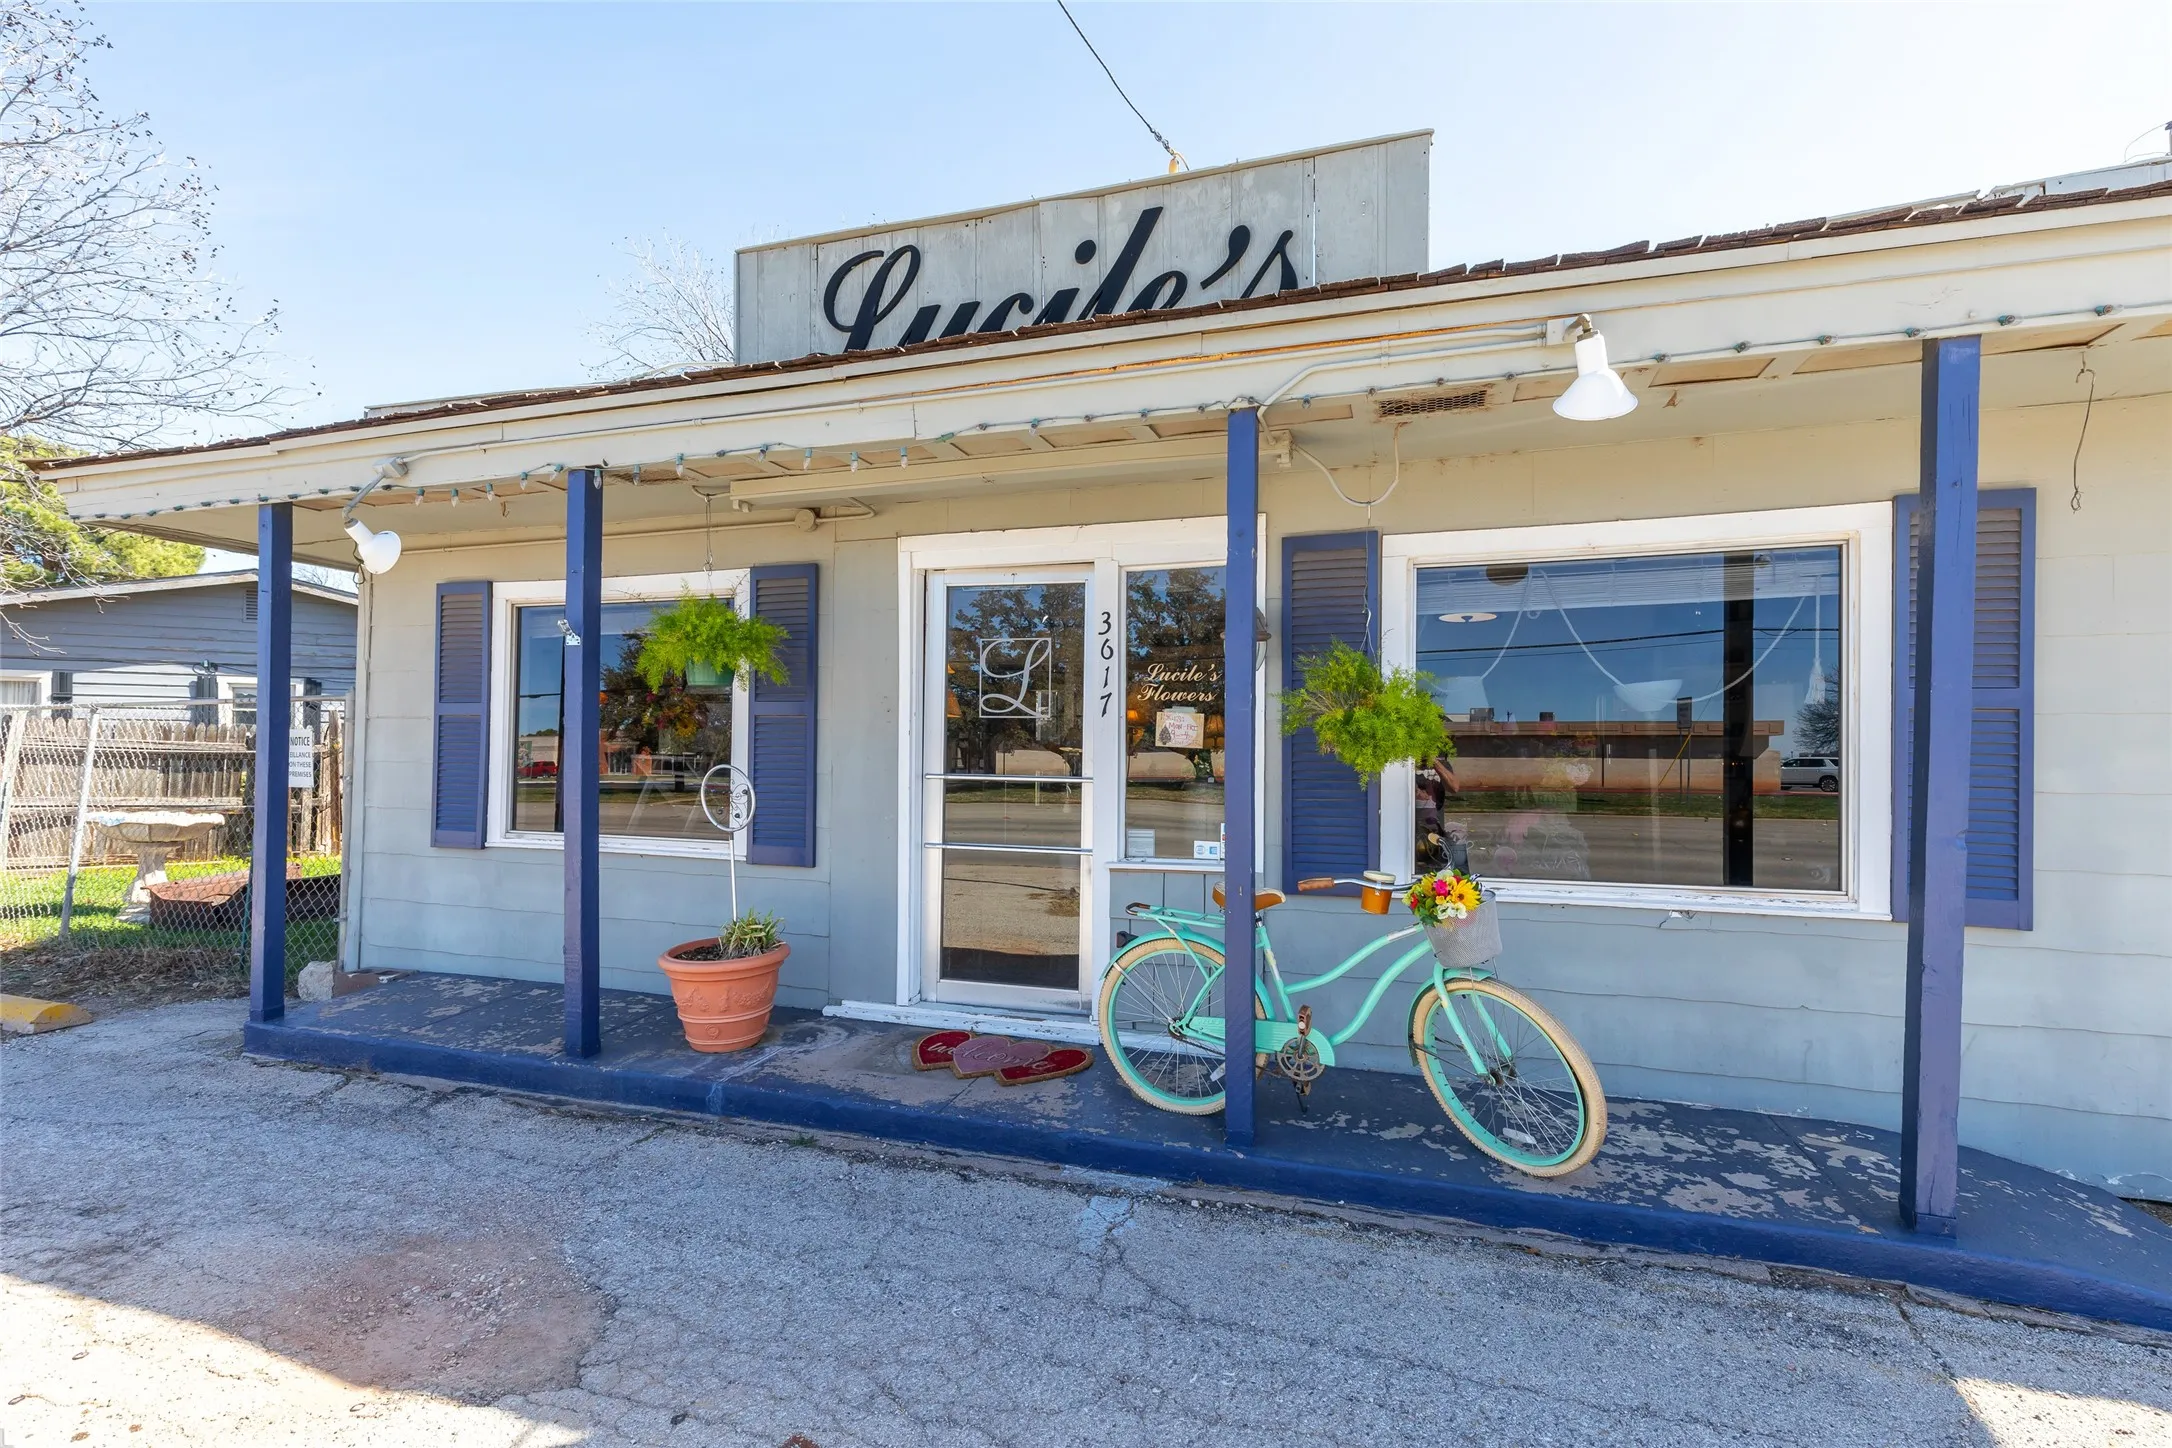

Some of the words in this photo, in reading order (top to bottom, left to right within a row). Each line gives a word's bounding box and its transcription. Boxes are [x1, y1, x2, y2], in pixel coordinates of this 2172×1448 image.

[823, 206, 1299, 353] Lucile's
[1098, 611, 1114, 718] 3617
[1143, 663, 1222, 682] Lucile's
[1137, 683, 1217, 702] Flowers
[289, 736, 310, 747] NOTICE
